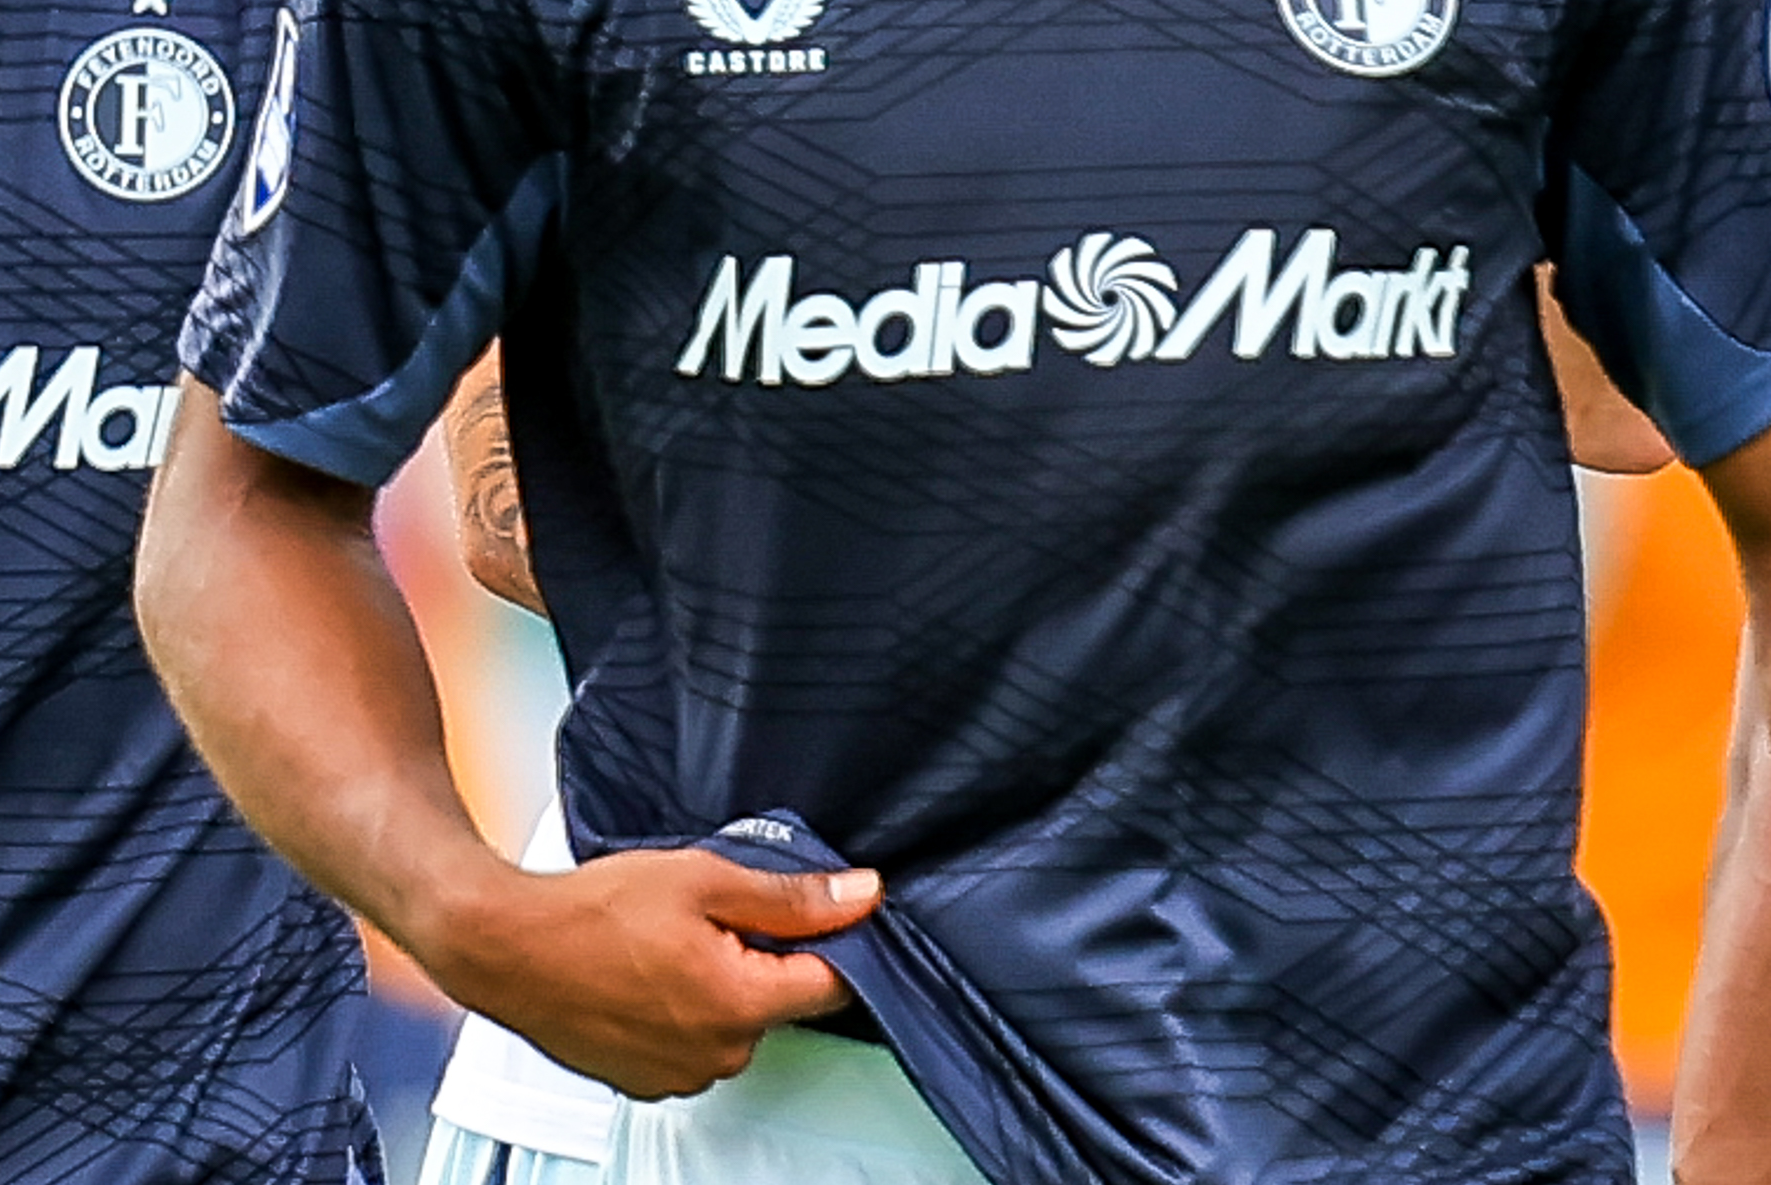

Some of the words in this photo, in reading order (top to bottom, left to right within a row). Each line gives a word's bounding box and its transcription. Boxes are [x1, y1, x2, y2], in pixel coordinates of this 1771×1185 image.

[77, 37, 220, 95] FEYENOORD
[687, 48, 826, 75] CASTORE
[1296, 12, 1443, 66] ROTTERDAM
[74, 134, 218, 192] ROTTERDAM
[677, 255, 1039, 386] Media
[1154, 229, 1469, 360] Markt
